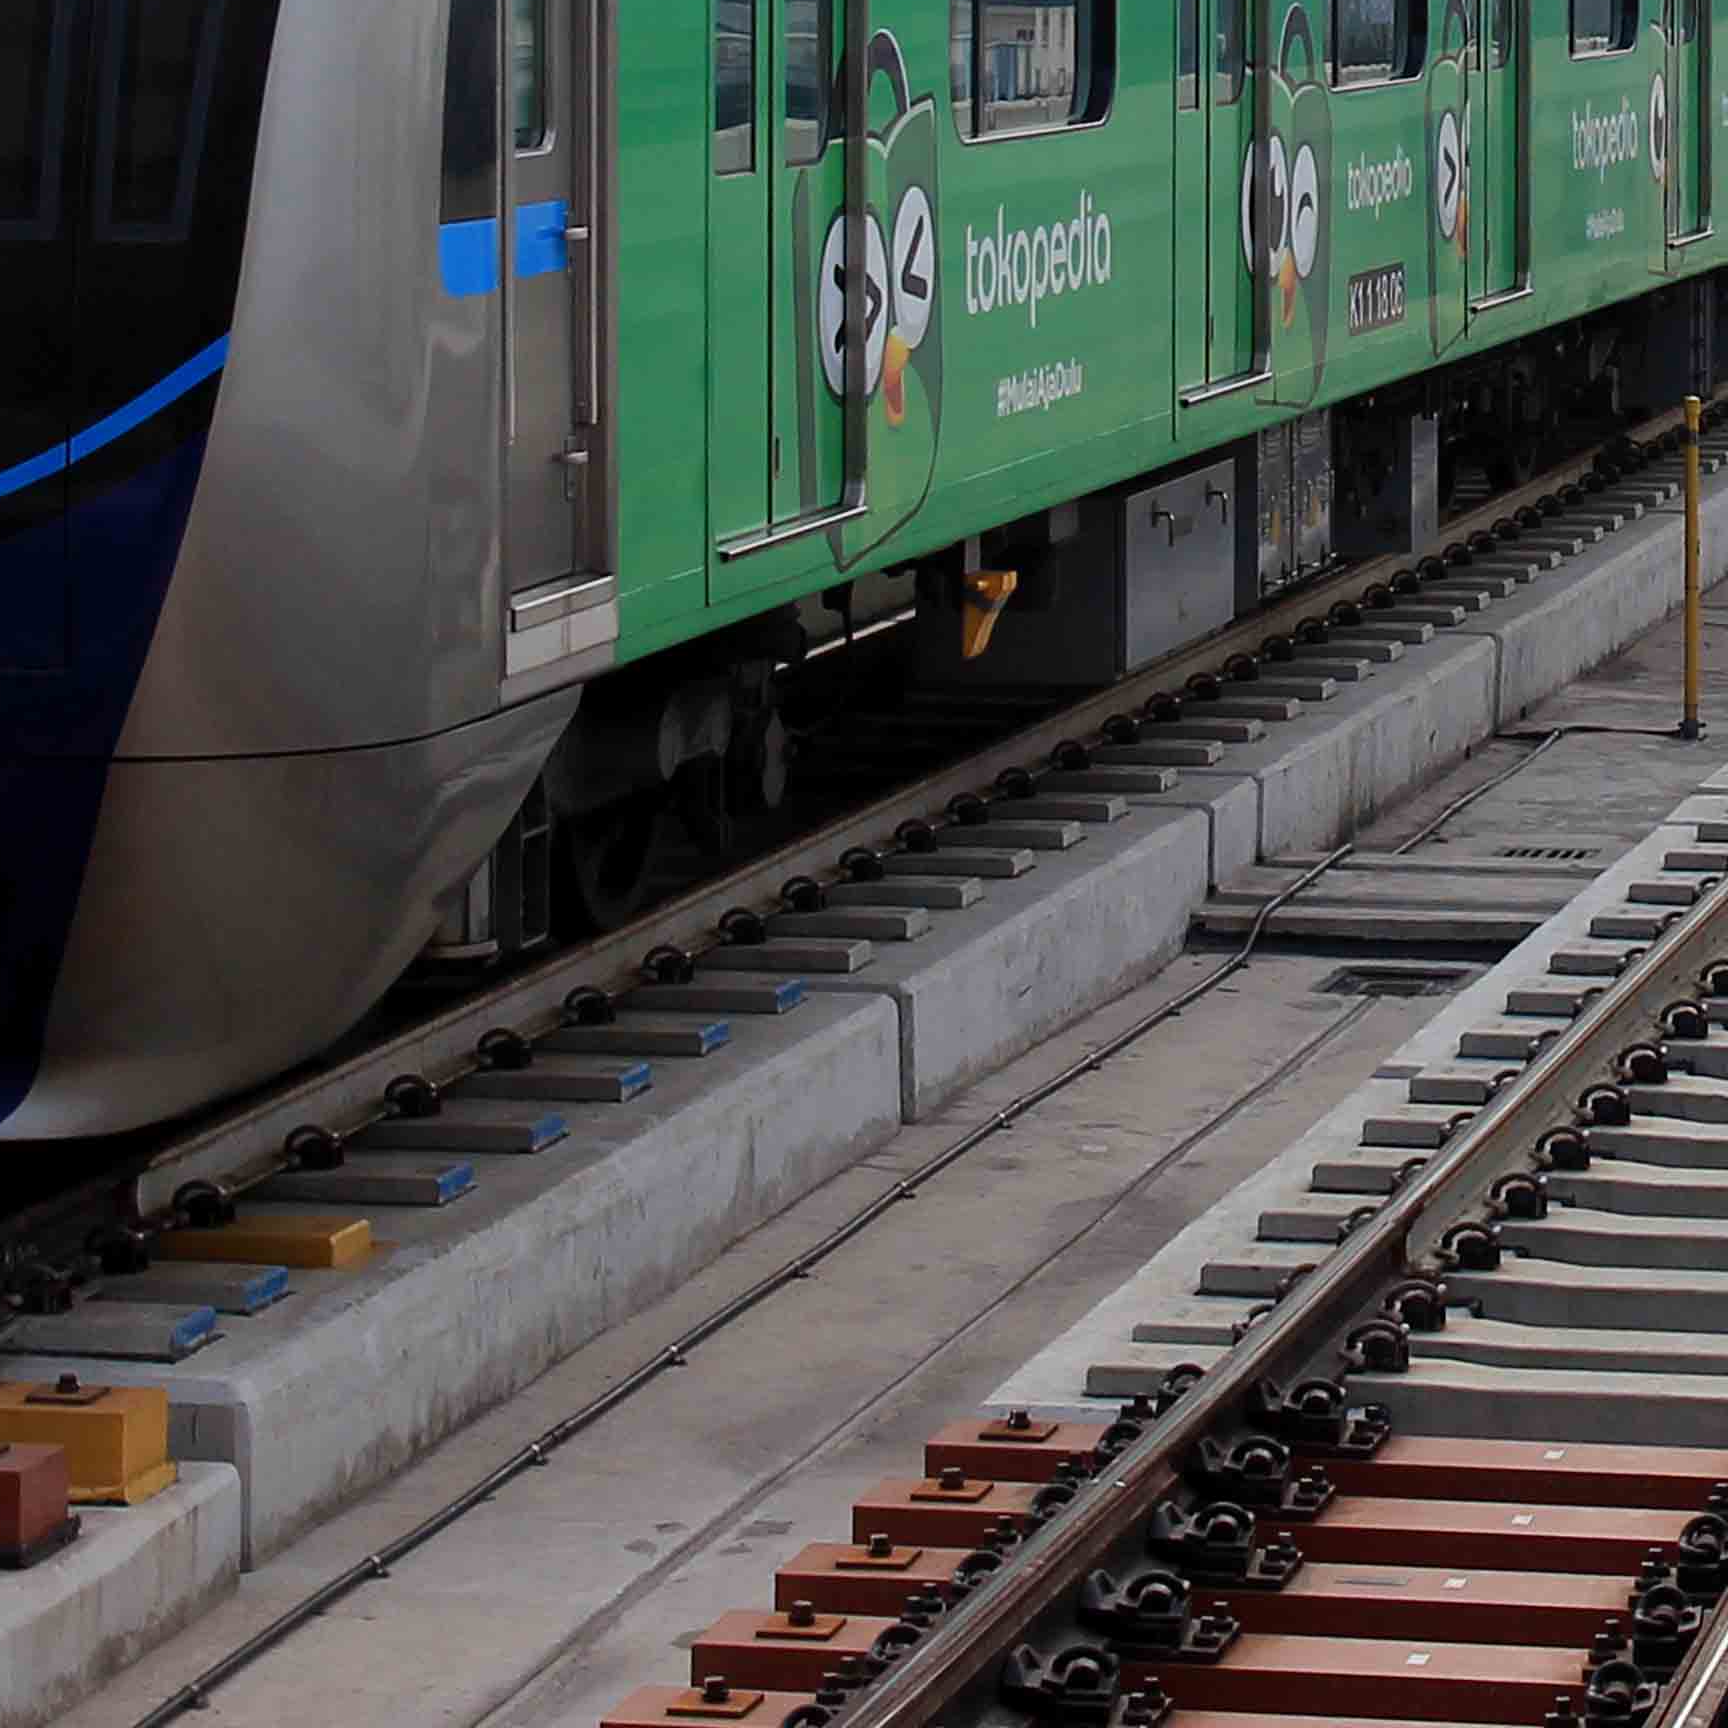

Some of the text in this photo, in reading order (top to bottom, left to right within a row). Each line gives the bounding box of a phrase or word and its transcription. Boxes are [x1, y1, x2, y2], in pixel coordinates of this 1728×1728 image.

[1346, 144, 1413, 221] tokopedia
[1571, 96, 1638, 184] tokopedia
[966, 188, 1112, 329] tokopedia
